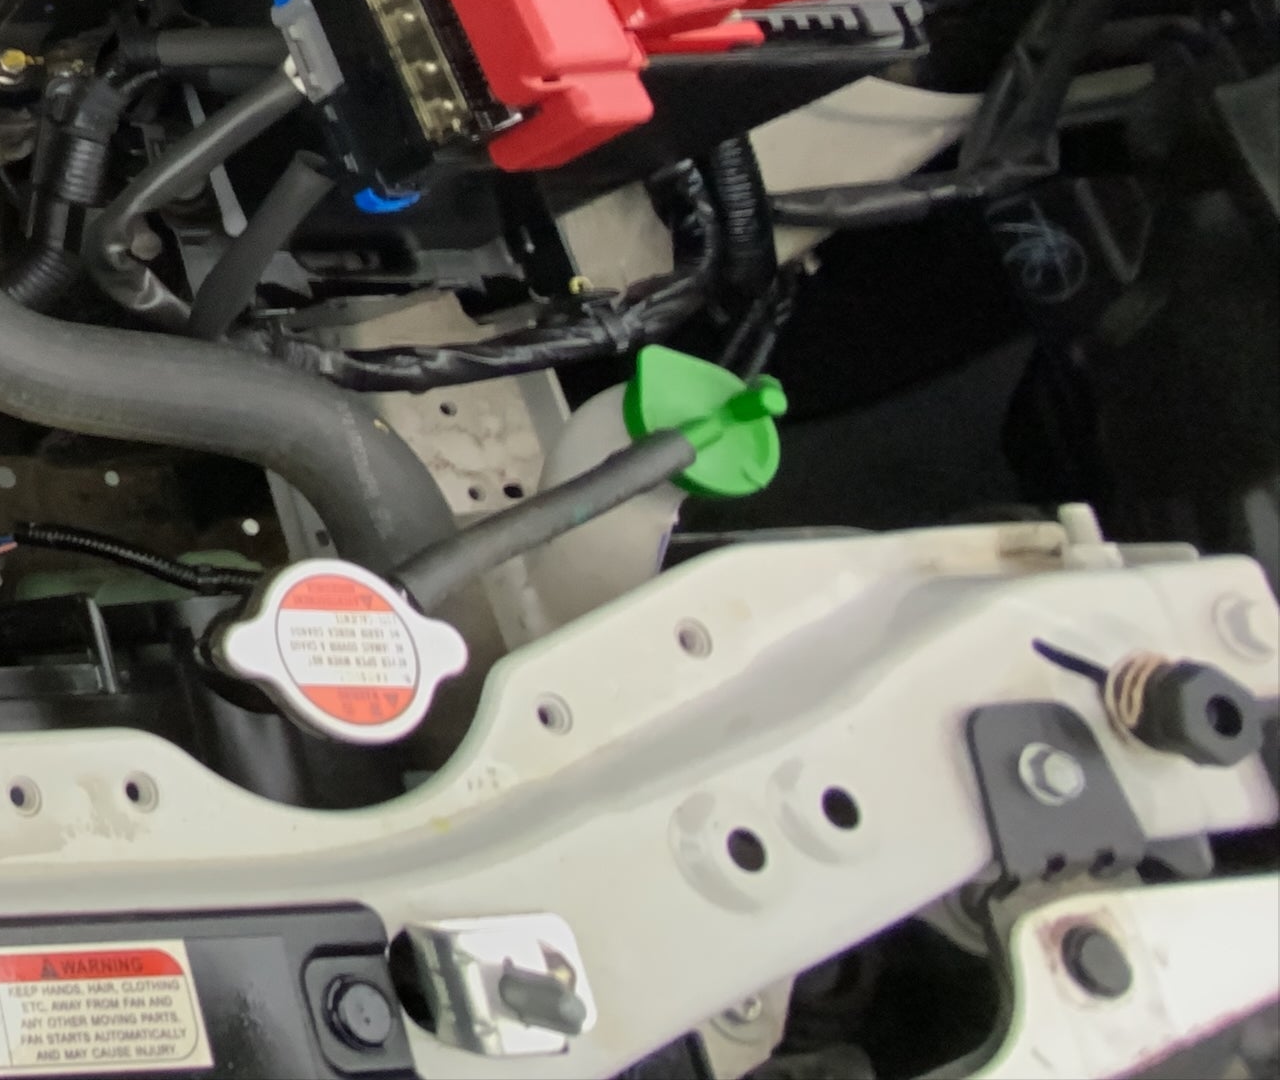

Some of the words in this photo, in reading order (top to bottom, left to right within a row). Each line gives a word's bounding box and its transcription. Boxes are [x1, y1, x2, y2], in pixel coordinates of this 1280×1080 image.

[61, 957, 144, 975] WARNING
[9, 985, 38, 997] KEEP
[122, 980, 180, 992] CLOTHING
[52, 1000, 82, 1011] AWAY
[87, 998, 119, 1010] FROM
[124, 997, 146, 1008] FAN
[150, 996, 173, 1007] AND
[21, 1018, 44, 1029] ANY
[48, 1016, 88, 1028] OTHER
[90, 1014, 137, 1027] MOVING
[21, 1035, 44, 1046] FAN
[48, 1033, 90, 1045] STARTS
[95, 1029, 187, 1042] AUTOMATICALLY
[37, 1050, 60, 1062] AND
[65, 1048, 88, 1060] MAY
[93, 1047, 131, 1059] CAUSE
